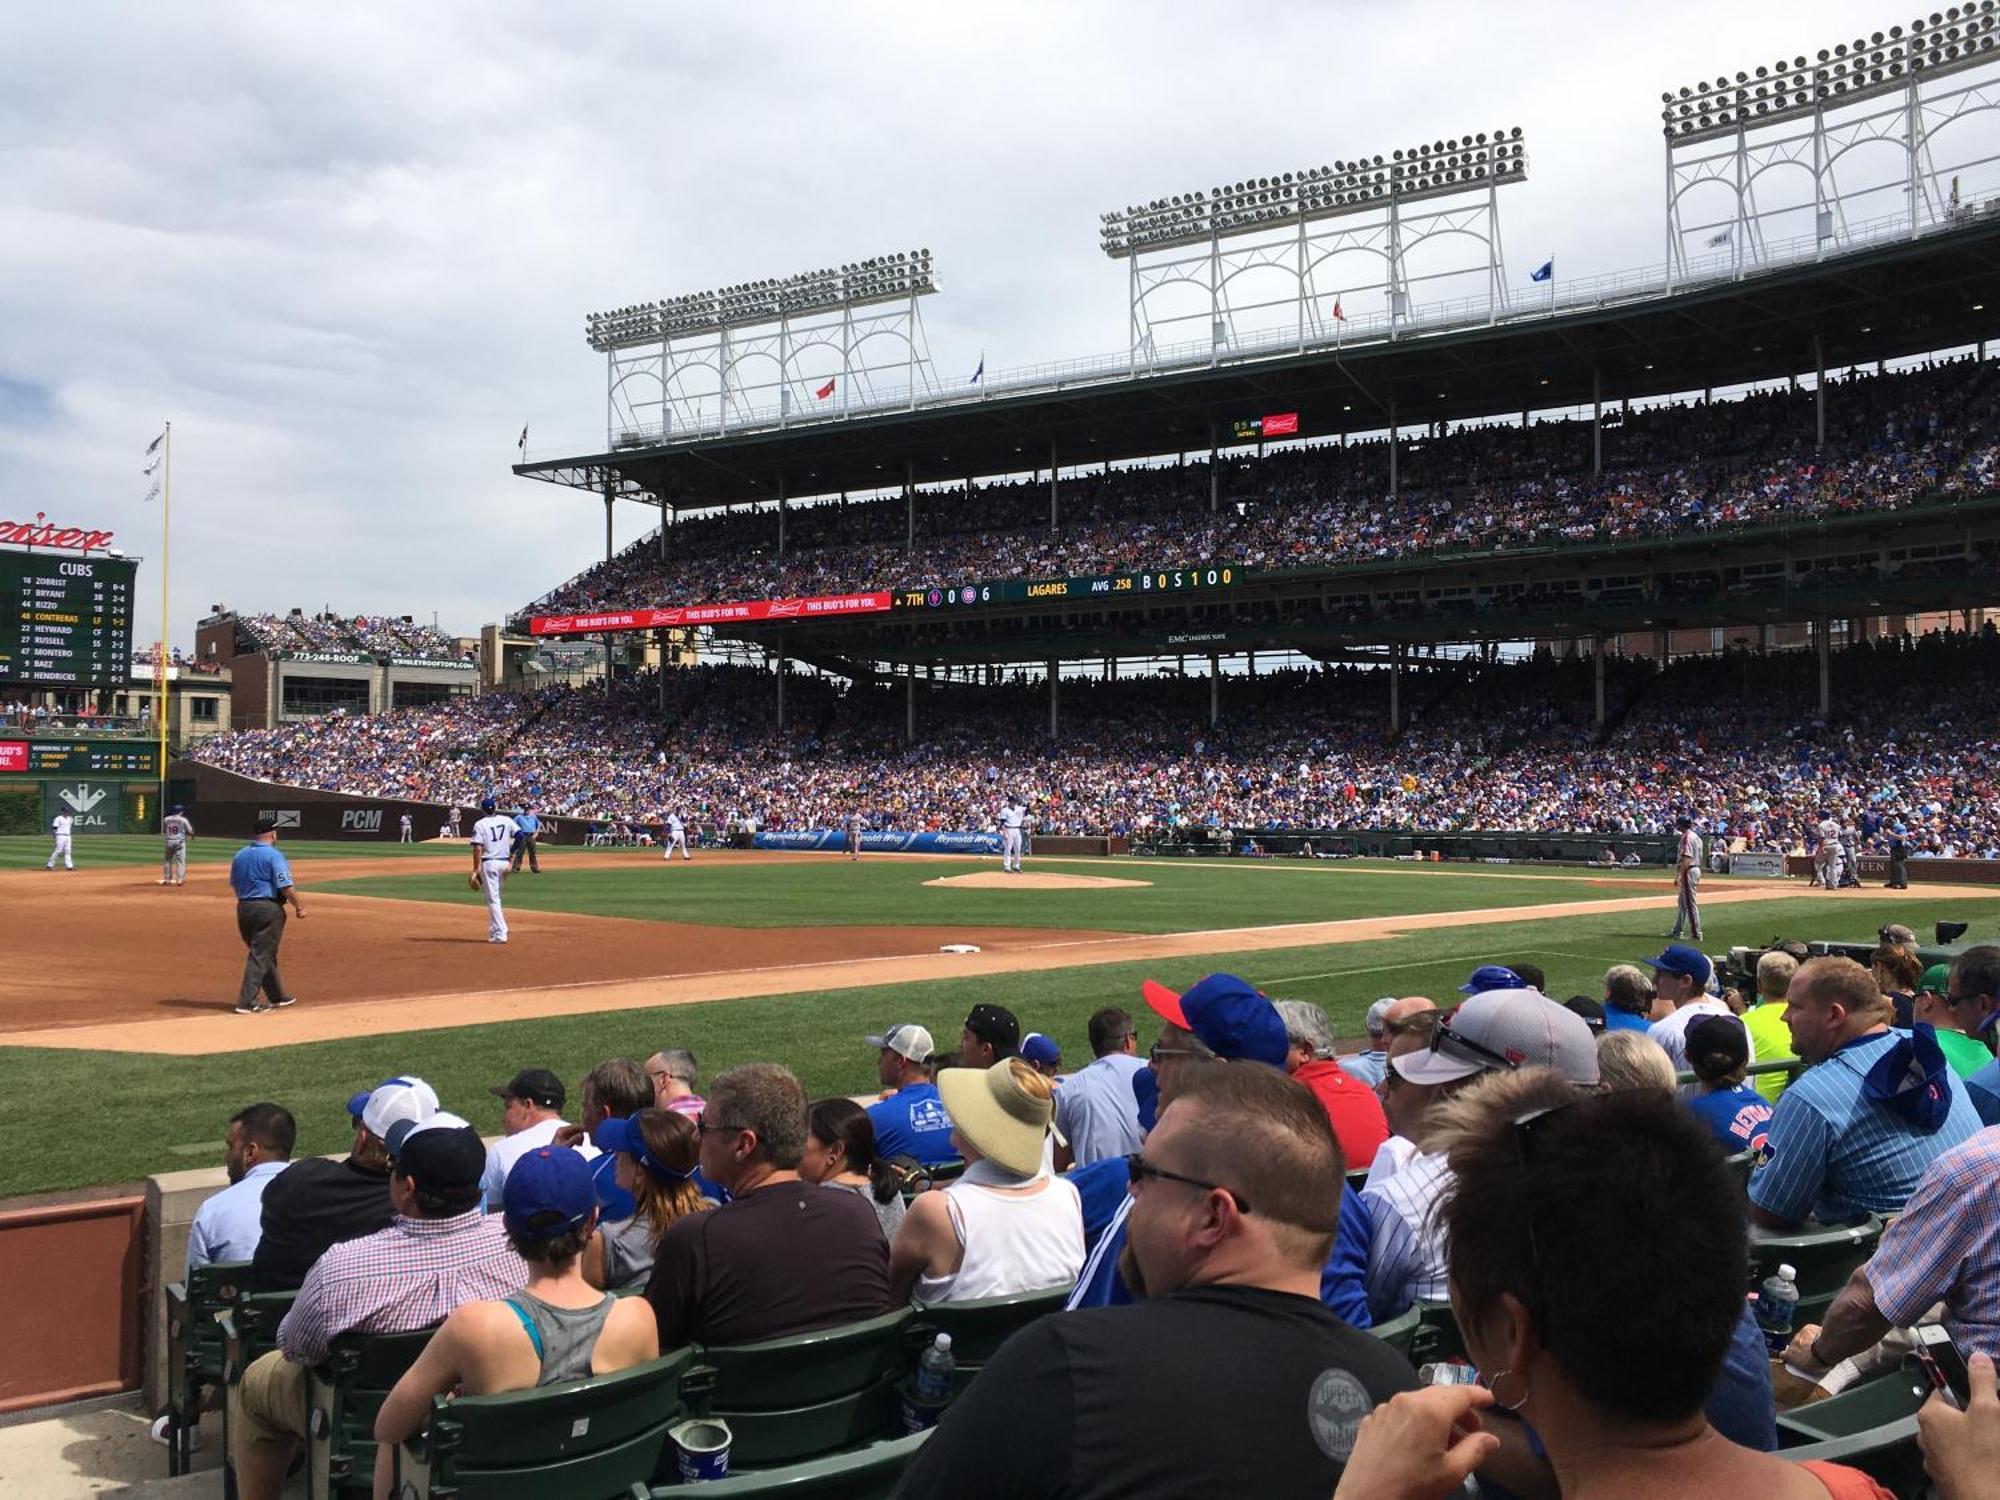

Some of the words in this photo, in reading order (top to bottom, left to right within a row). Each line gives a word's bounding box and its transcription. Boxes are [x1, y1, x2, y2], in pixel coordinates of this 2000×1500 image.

[60, 562, 93, 577] CUBS
[35, 577, 67, 587] ZOBRIST
[94, 582, 103, 590] RF
[1027, 583, 1067, 597] LAGARES
[1092, 580, 1109, 592] AVG
[1112, 578, 1132, 590] .258
[1143, 575, 1151, 589] B
[1158, 574, 1167, 589] 0
[1174, 573, 1182, 587] S
[1191, 571, 1199, 586] 1
[1222, 569, 1231, 584] 0
[35, 589, 66, 598] BRYANT
[906, 593, 924, 606] 7TH
[948, 590, 955, 604] 0
[982, 587, 990, 600] 6
[35, 601, 58, 609] RIZZO
[807, 602, 822, 611] THIS
[823, 600, 844, 610] BUD'S
[845, 599, 859, 608] FOR
[860, 598, 876, 607] YOU.
[35, 613, 79, 623] CONTRERAS
[686, 610, 700, 620] THIS
[701, 609, 720, 619] BUD'S
[721, 608, 734, 616] FOR
[576, 618, 589, 628] THIS
[589, 617, 607, 627] BUD'S
[608, 616, 620, 625] FOR
[34, 625, 73, 634] HEYWARD
[21, 636, 30, 644] 27
[34, 636, 65, 646] RUSSELL
[34, 648, 73, 657] MONTERO
[293, 652, 360, 663] 773-248-ROOF
[34, 660, 54, 669] BAEZ
[391, 658, 474, 669] WRIGLEYROOFTOPS.COM
[34, 671, 76, 681] HENDRICKS
[73, 815, 107, 826] EAL
[341, 810, 383, 829] PCM
[539, 820, 558, 834] AN
[490, 824, 505, 842] 17
[763, 832, 798, 842] Reynolds
[799, 832, 818, 843] Wrap
[860, 833, 884, 842] nolds
[884, 833, 905, 844] Wrap
[1826, 829, 1837, 839] 12
[935, 834, 973, 845] Reynolds
[974, 835, 998, 846] Wrap
